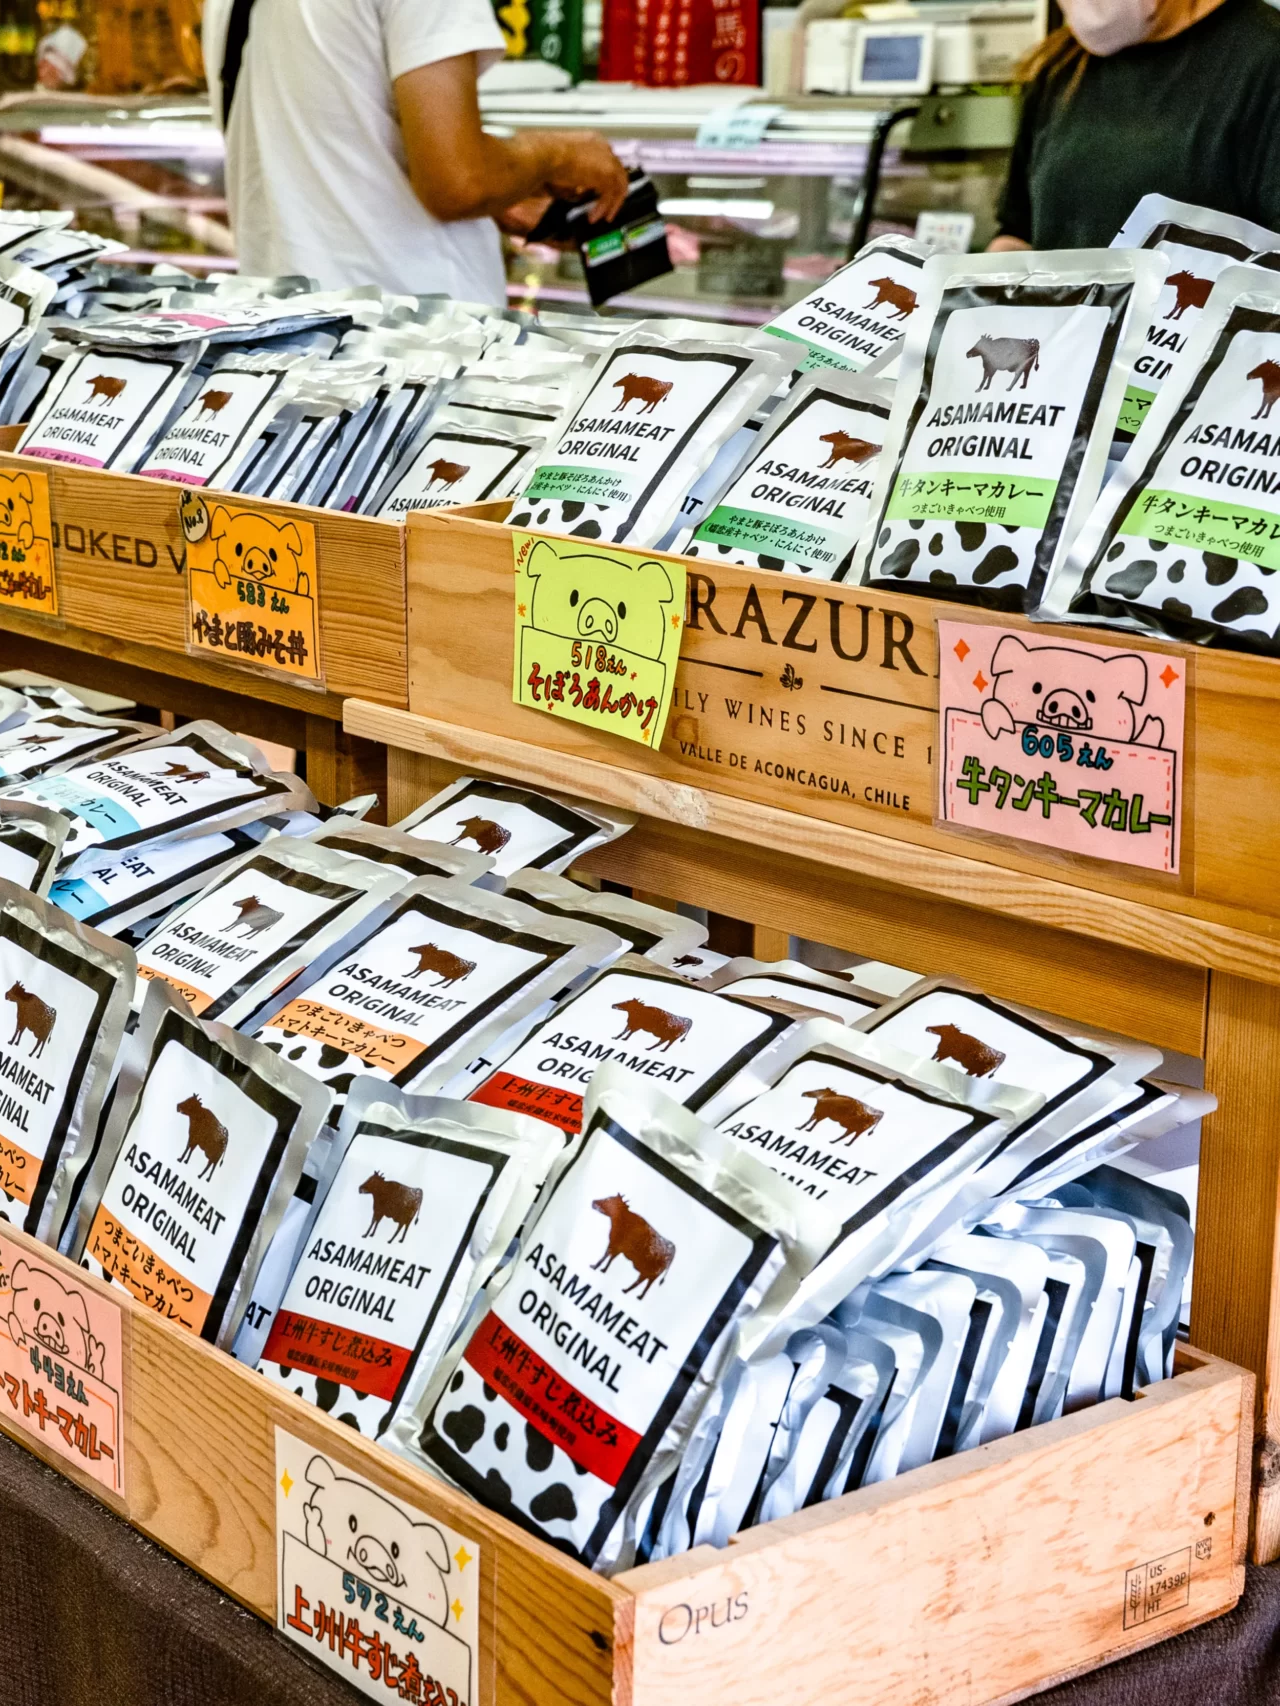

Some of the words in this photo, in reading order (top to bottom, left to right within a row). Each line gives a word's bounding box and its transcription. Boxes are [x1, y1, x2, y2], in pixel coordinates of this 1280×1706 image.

[797, 315, 888, 359] ORIGINAL
[42, 426, 100, 447] ORIGINAL
[926, 401, 1066, 428] ASAMAMEAT
[154, 447, 206, 467] ORIGINAL
[557, 440, 641, 463] ORIGINAL
[926, 435, 1034, 461] ORIGINAL
[750, 483, 847, 519] ORIGINAL
[899, 477, 1045, 500] 牛タンキーマカレー
[911, 503, 1007, 519] つまごいきゃべつ使用
[729, 514, 827, 546] やまと豚そぼろあんかけ
[1154, 522, 1266, 558] つまごいきゃべつ使用
[687, 571, 939, 679] RAZUR
[571, 641, 628, 676] 518えん
[527, 662, 659, 730] そぼろあんかけ
[725, 698, 808, 736] WINES
[823, 720, 906, 759] SINCE
[1021, 724, 1114, 771] 605えん
[86, 770, 152, 808] ORIGINAL
[679, 740, 723, 764] VALLE
[729, 752, 748, 770] DE
[754, 759, 856, 800] ACONCAGUA,
[864, 788, 911, 811] CHILE
[956, 755, 1172, 834] 牛タンキーマカレー
[151, 942, 225, 980] ORIGINAL
[166, 922, 259, 963] ASAMAMEAT
[327, 983, 424, 1028] ORIGINAL
[338, 962, 467, 1013] ASAMAMEAT
[272, 1014, 396, 1067] トマトキーマカレー
[296, 1002, 407, 1049] つまごいきゃべつ
[723, 1120, 879, 1188] ASAMAMEAT
[123, 1143, 227, 1237] ASAMAMEAT
[120, 1183, 198, 1264] ORIGINAL
[91, 1237, 194, 1331] トマトキーマカレー
[103, 1218, 195, 1303] つまごいきゃべつ
[307, 1237, 432, 1290] ASAMAMEAT
[305, 1275, 397, 1323] ORIGINAL
[525, 1242, 669, 1366] ASAMAMEAT
[279, 1314, 394, 1368] 上州牛すじ煮込み
[518, 1288, 623, 1394] ORIGINAL
[30, 1345, 89, 1407] 443えん
[488, 1324, 620, 1447] 上州牛すじ煮込み
[1147, 1598, 1162, 1615] HT
